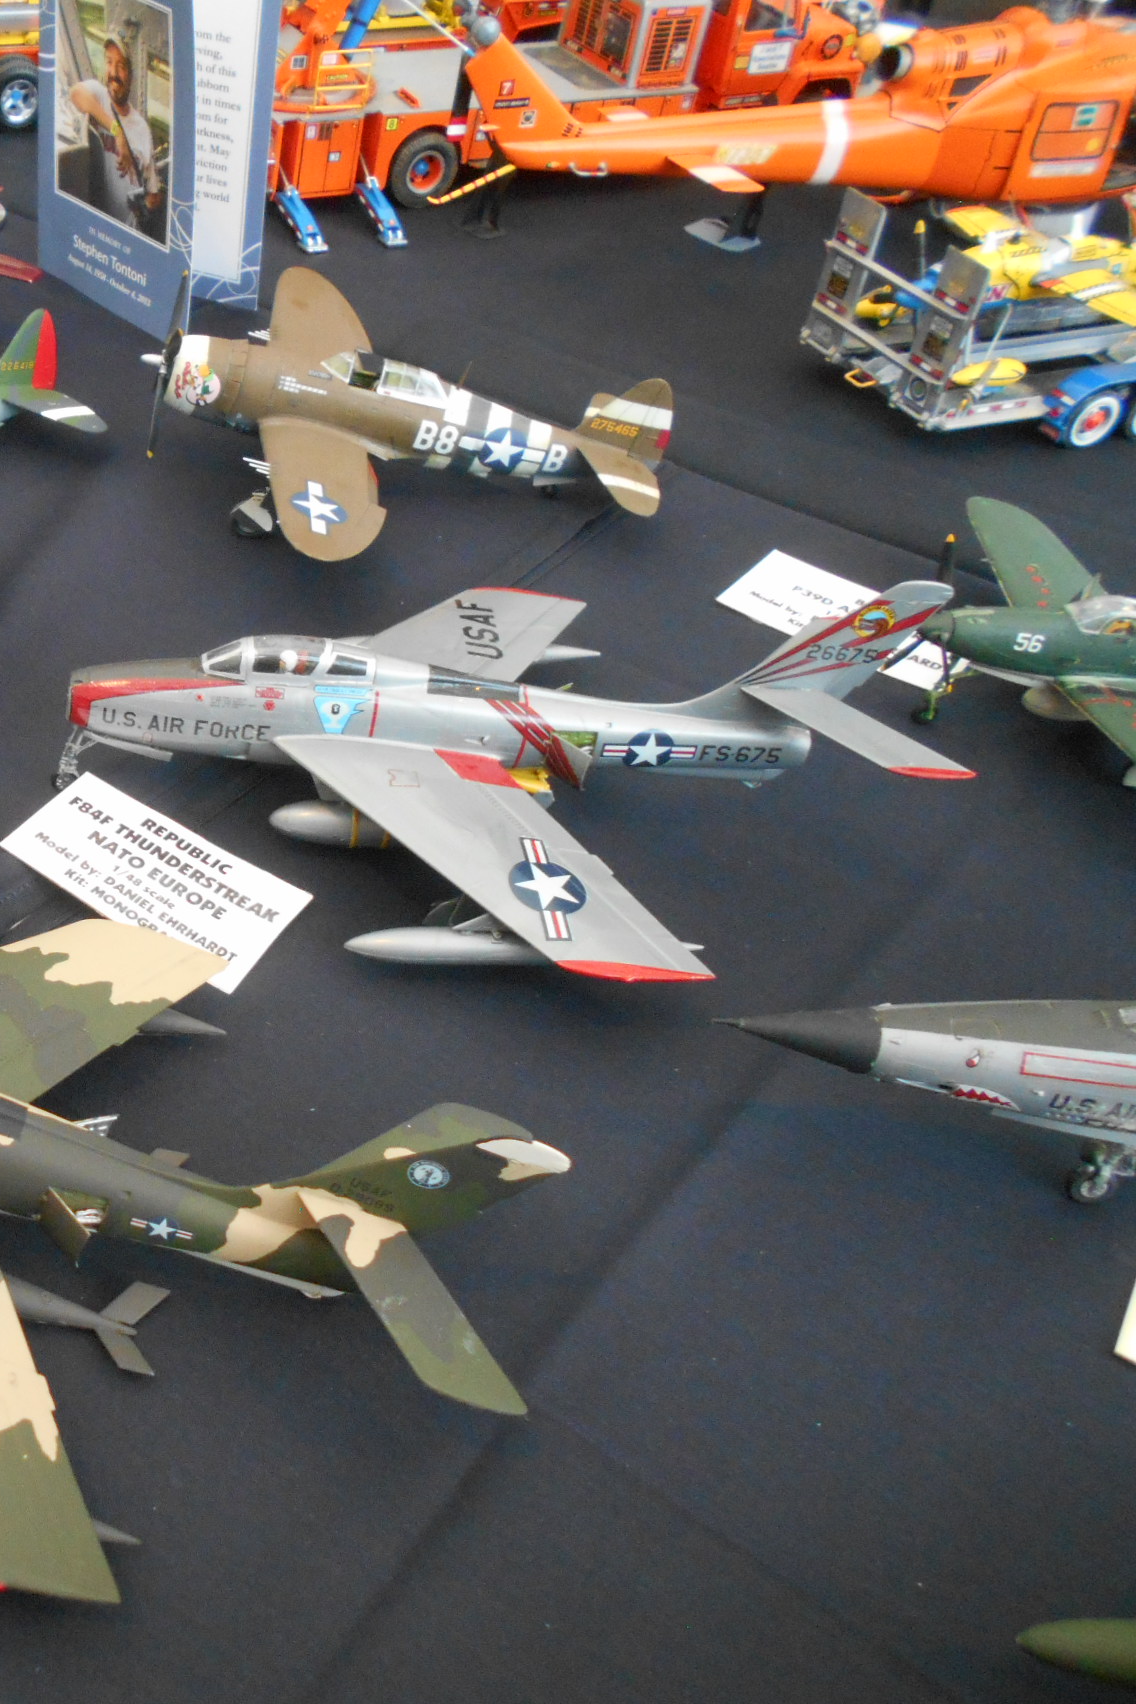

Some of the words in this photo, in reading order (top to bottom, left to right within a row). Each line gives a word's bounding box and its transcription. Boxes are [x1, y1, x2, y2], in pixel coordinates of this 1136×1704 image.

[215, 31, 232, 44] the
[196, 48, 224, 61] ving,
[206, 63, 216, 75] of
[218, 65, 237, 79] this
[215, 98, 241, 113] times
[214, 113, 228, 126] for
[210, 144, 231, 160] May
[206, 175, 228, 188] lives
[203, 191, 230, 204] world
[73, 234, 109, 266] Stephen
[110, 255, 148, 288] Tontoni
[412, 419, 460, 455] B8
[590, 416, 641, 439] 275465
[541, 443, 569, 473] B
[749, 590, 784, 610] Model
[455, 599, 504, 661] USAF
[806, 643, 879, 665] 26675
[1013, 632, 1045, 654] 56
[102, 707, 143, 730] U.S.
[147, 715, 185, 735] AIR
[193, 720, 271, 743] FORCE
[140, 817, 235, 876] REPUBLIC
[67, 795, 115, 827] F84F
[114, 822, 282, 925] THUNDERSTREAK
[63, 868, 89, 888] Kit:
[86, 829, 146, 871] NATO
[146, 868, 229, 922] EUROPE
[34, 830, 79, 864] Model
[79, 858, 101, 881] by:
[103, 875, 156, 916] DANIEL
[158, 911, 239, 964] EHRHARDT
[112, 865, 143, 888] 1/48
[142, 885, 177, 911] scale
